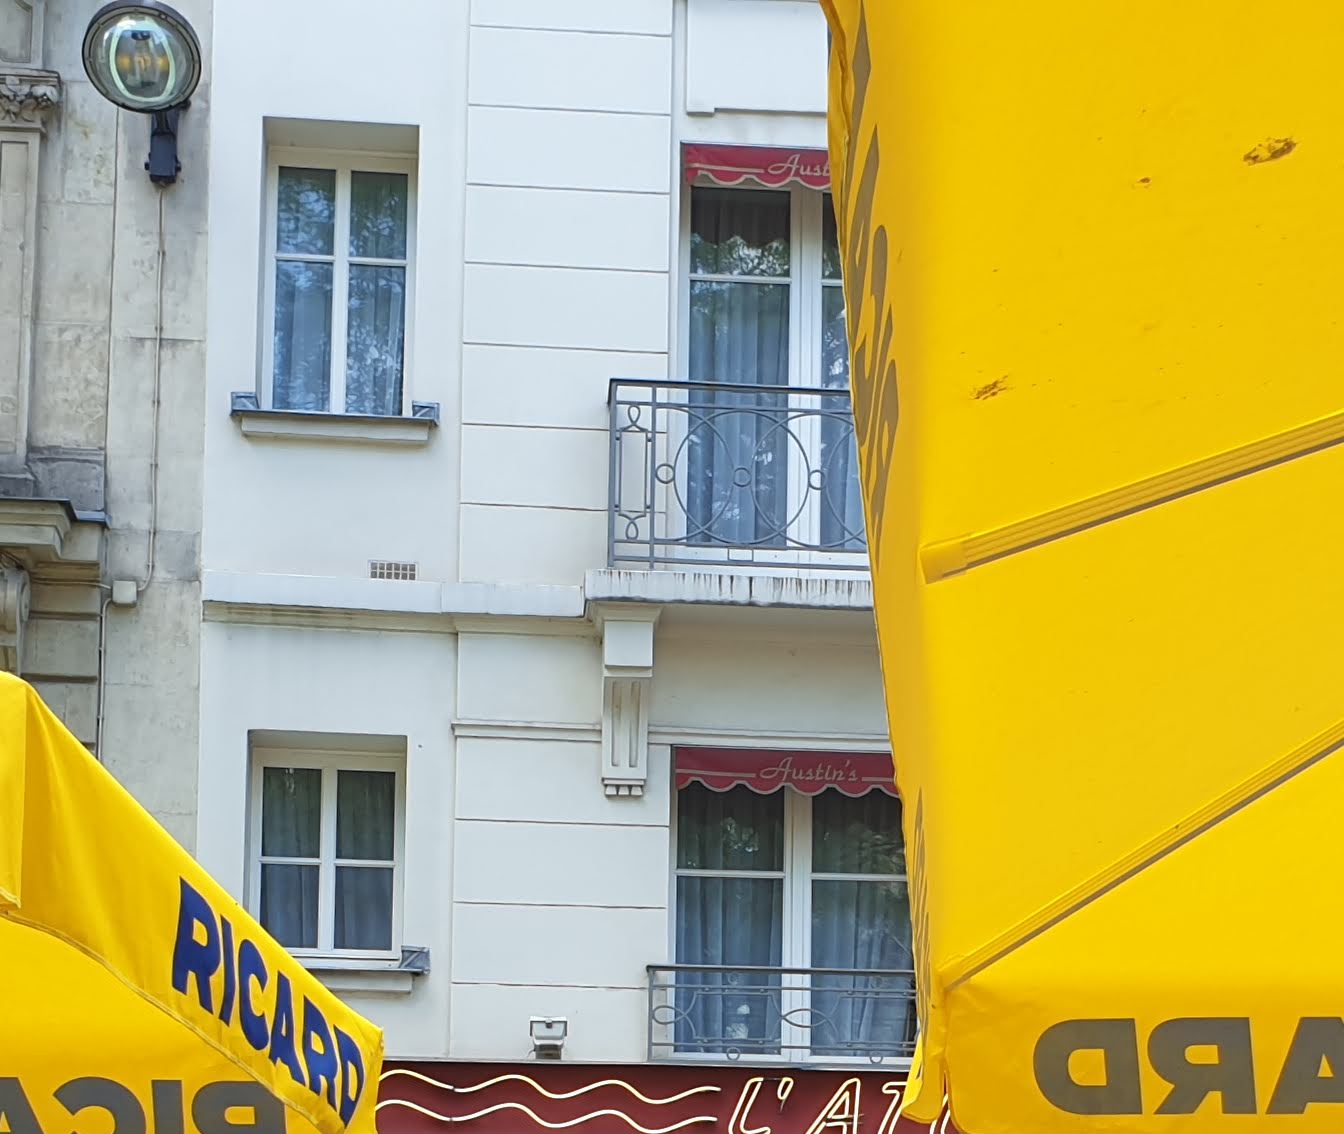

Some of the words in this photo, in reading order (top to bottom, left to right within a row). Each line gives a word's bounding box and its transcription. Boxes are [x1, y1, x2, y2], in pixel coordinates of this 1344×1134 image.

[767, 154, 831, 177] Aust
[759, 757, 858, 782] Austin's
[171, 877, 365, 1123] RICARD
